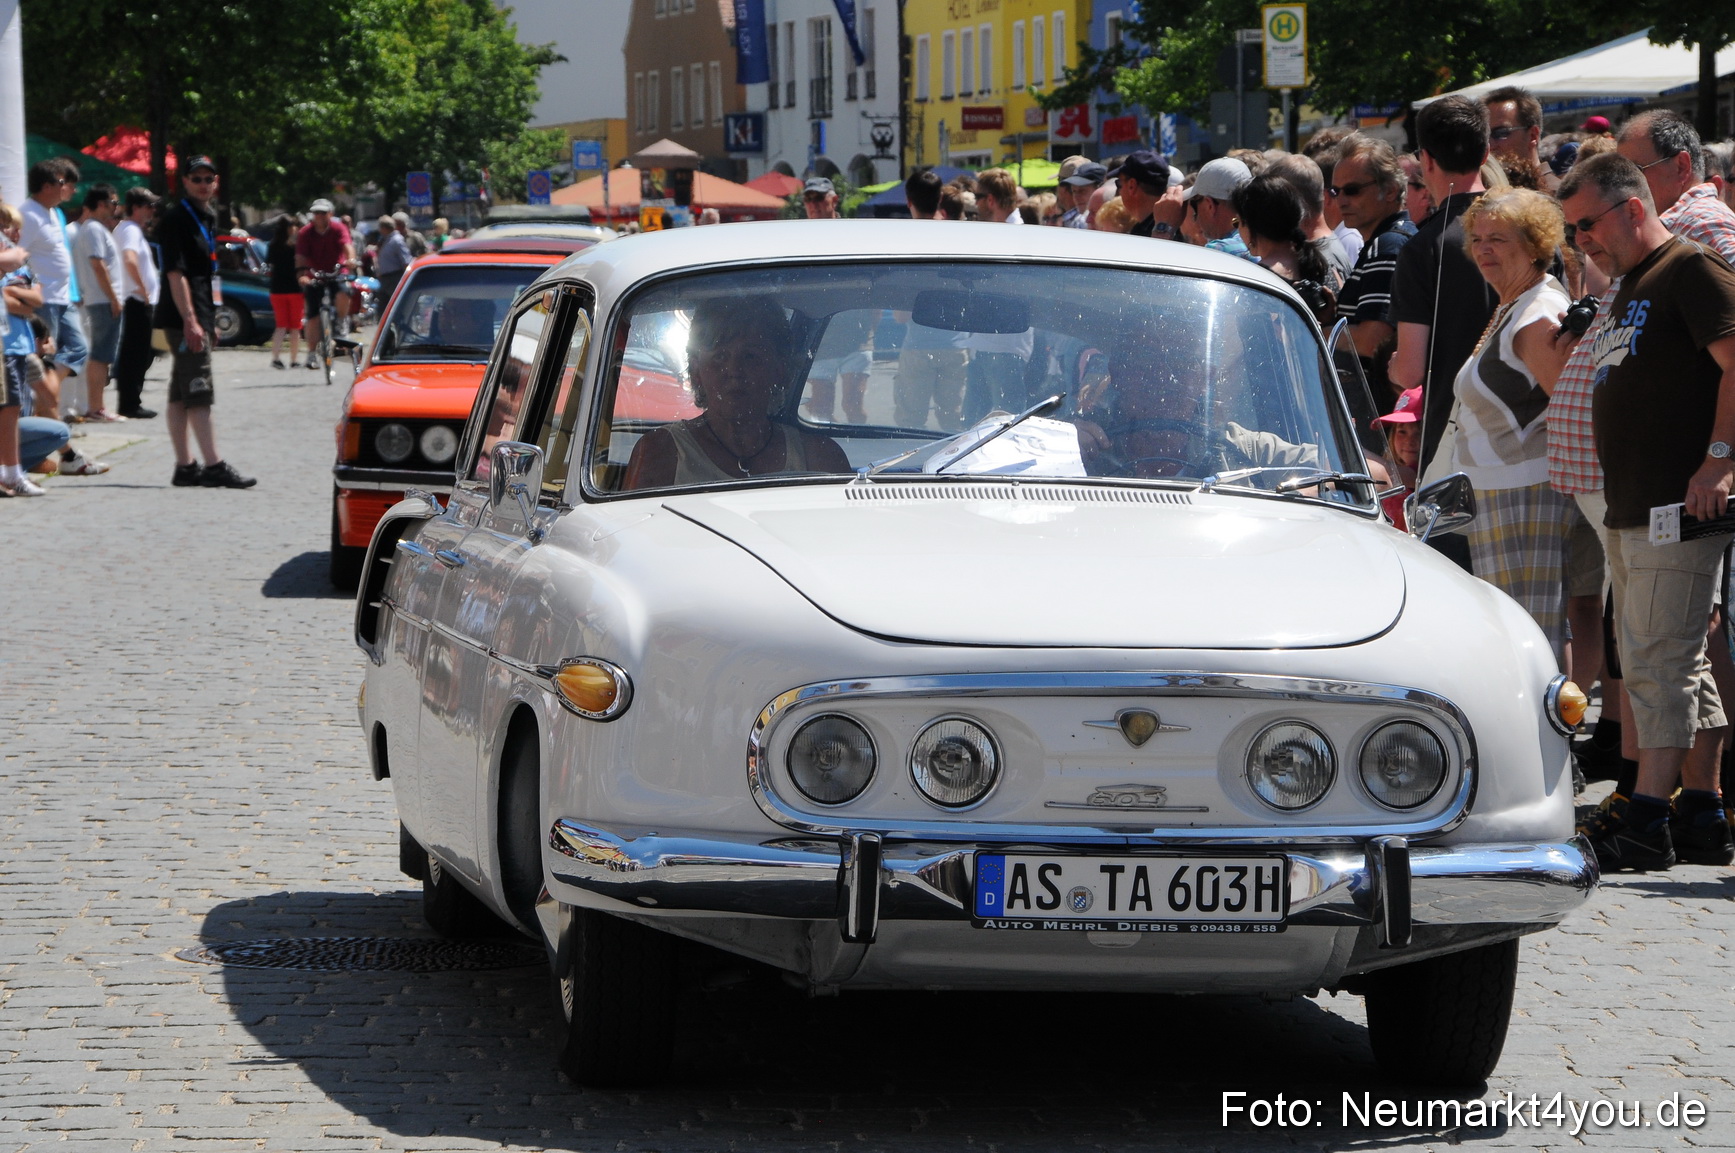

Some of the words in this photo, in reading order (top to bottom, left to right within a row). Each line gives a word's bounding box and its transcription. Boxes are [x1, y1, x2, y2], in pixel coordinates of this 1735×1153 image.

[1277, 17, 1292, 35] H
[1621, 300, 1651, 327] 36
[1007, 863, 1062, 910] AS
[1100, 865, 1152, 911] TA
[1168, 865, 1280, 912] 603H
[985, 892, 995, 905] D
[1200, 924, 1241, 932] 09438
[1253, 924, 1277, 932] 558
